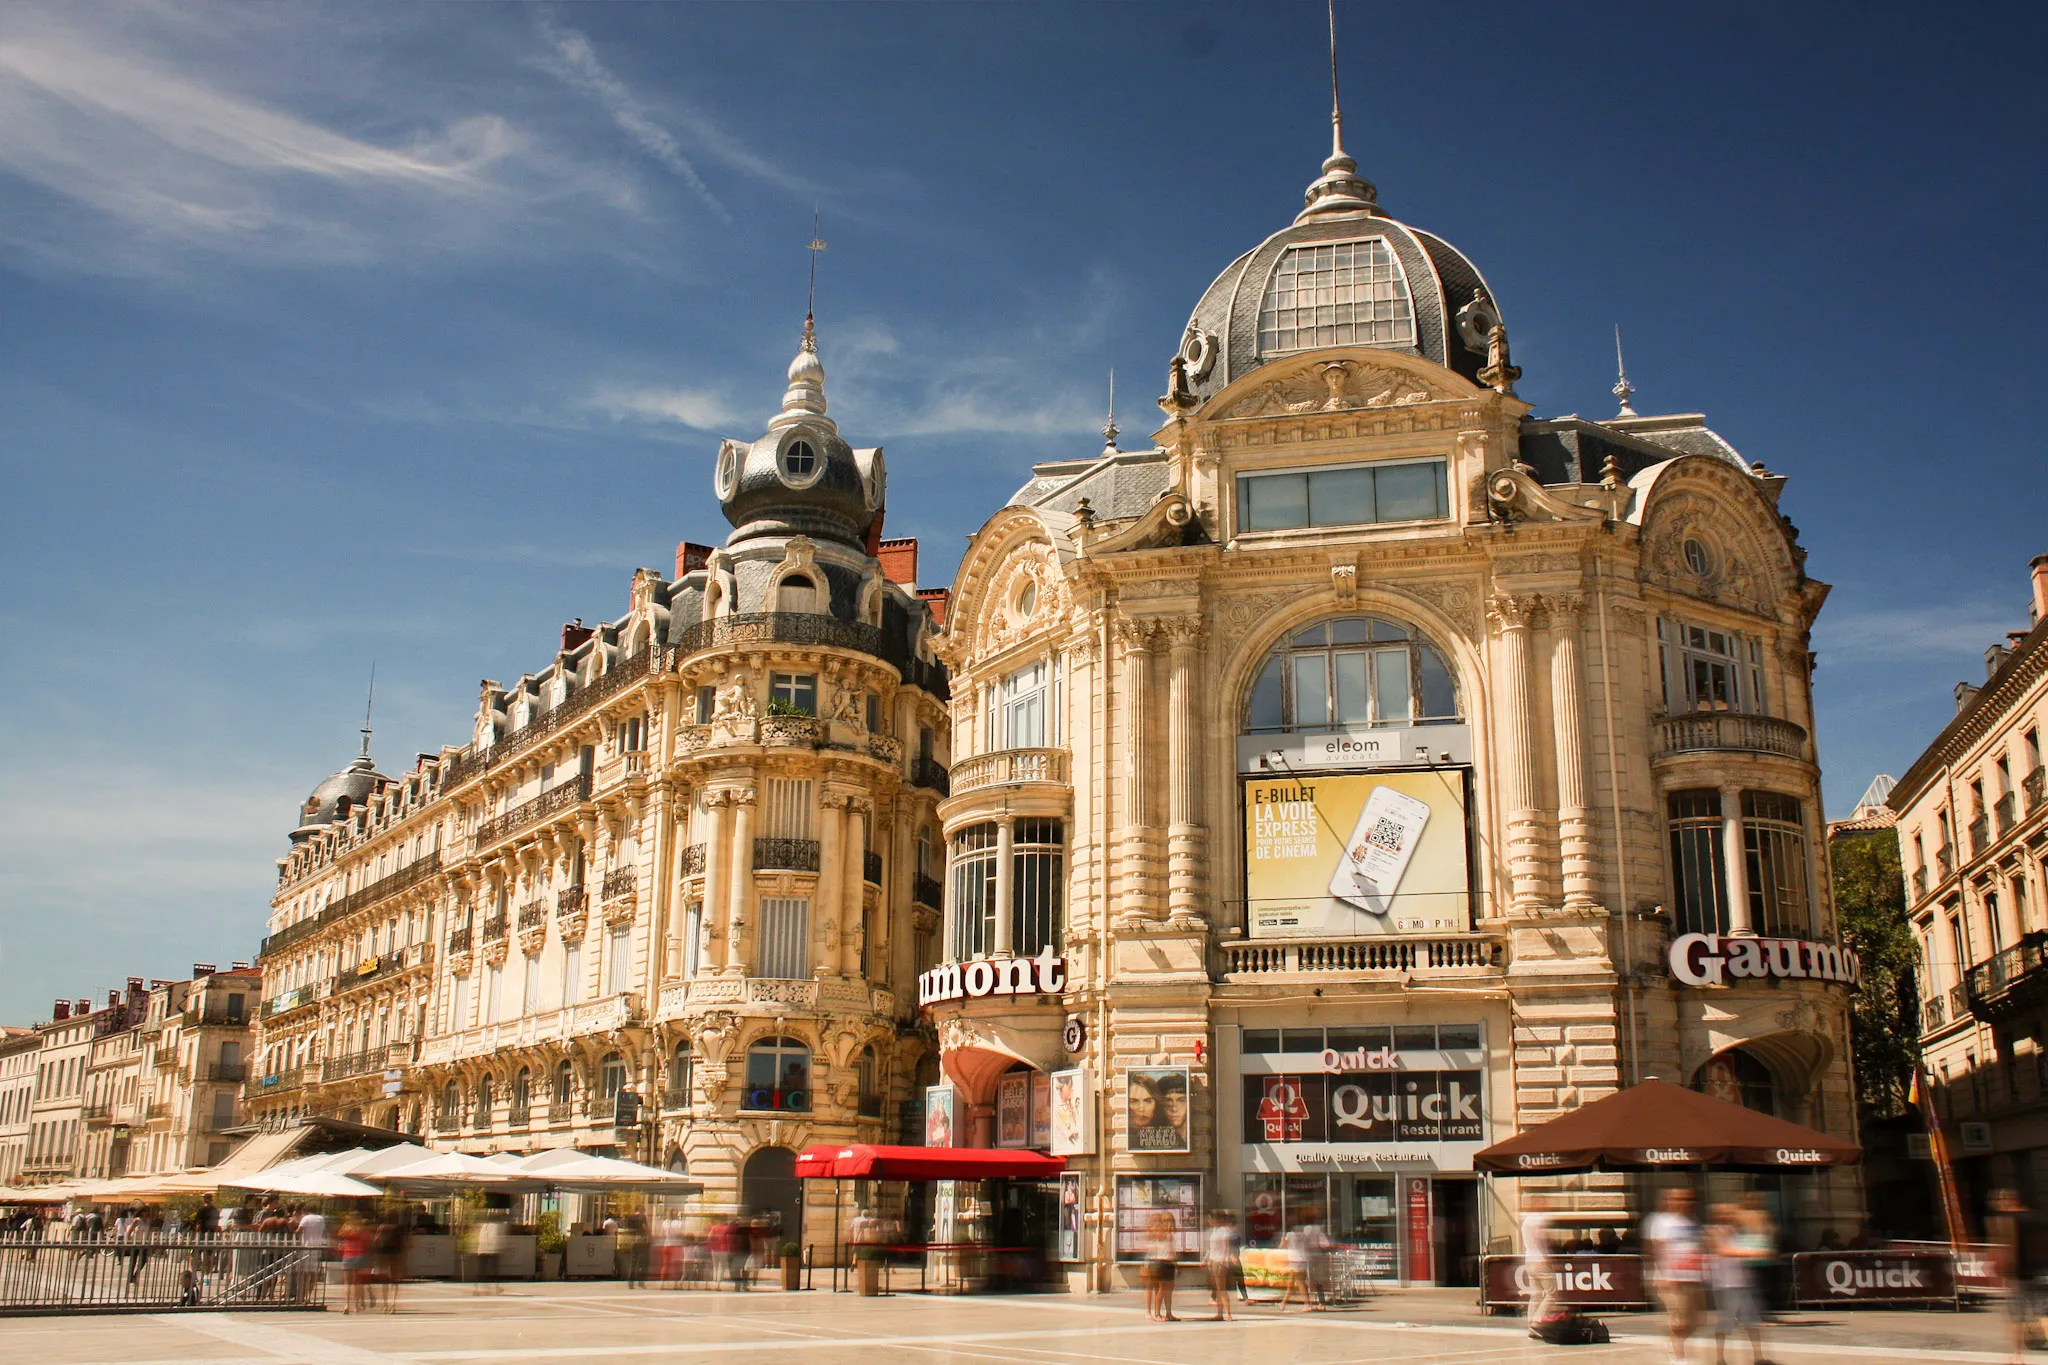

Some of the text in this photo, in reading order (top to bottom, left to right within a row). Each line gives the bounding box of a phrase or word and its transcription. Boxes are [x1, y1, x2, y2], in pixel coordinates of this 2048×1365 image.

[1326, 738, 1379, 752] eleom
[1326, 753, 1379, 762] avocats
[1256, 787, 1315, 804] E-BILLET
[1255, 801, 1316, 822] LA VOIE
[1256, 820, 1317, 837] EXPRESS
[1256, 846, 1271, 859] DE
[1670, 932, 1861, 988] Gaumo
[1320, 1046, 1399, 1075] Quick
[751, 1089, 804, 1109] CIC
[1333, 1081, 1479, 1129] Quick
[1401, 1124, 1481, 1135] Restaurant
[1296, 1152, 1430, 1164] Quality Burger Restaurant
[1518, 1153, 1561, 1168] Quick
[1646, 1148, 1690, 1163] Quick
[1776, 1148, 1822, 1164] Quick
[1826, 1260, 1924, 1296] Quick
